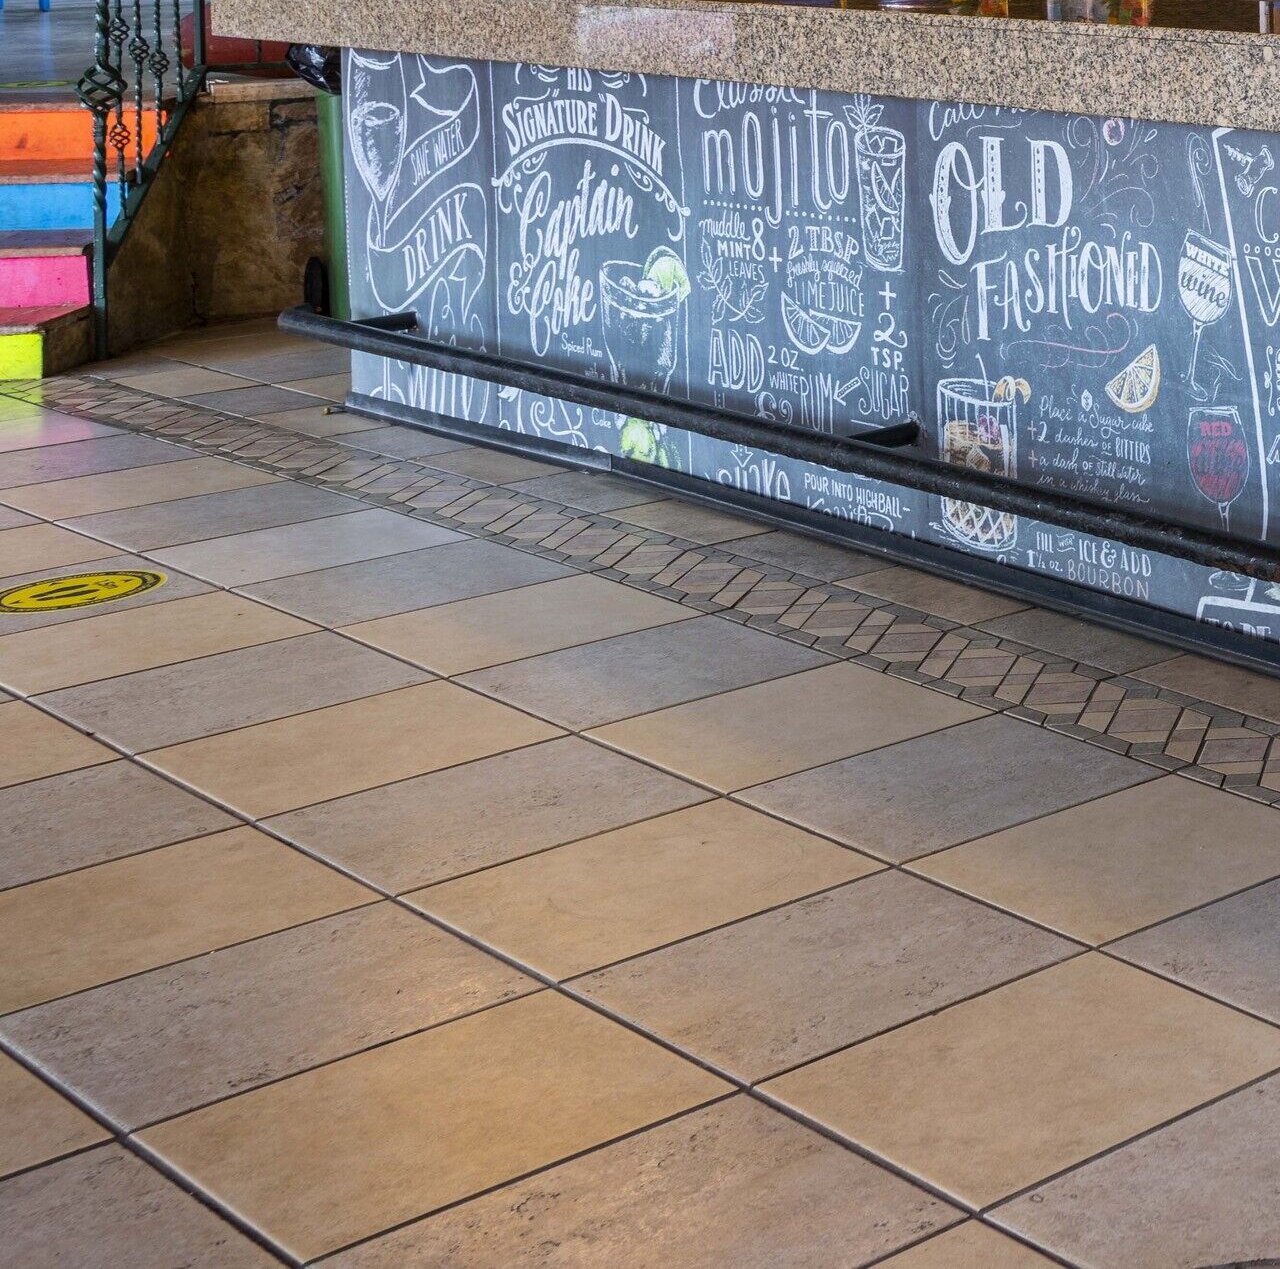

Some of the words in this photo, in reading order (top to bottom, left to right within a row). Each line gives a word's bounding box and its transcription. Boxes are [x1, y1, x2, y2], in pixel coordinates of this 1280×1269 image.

[410, 151, 431, 187] SAVE
[433, 119, 466, 170] WATER
[502, 92, 599, 158] SIGNATURE
[604, 92, 667, 178] DRINK
[702, 91, 850, 228] mojito
[930, 134, 1074, 266] OLD
[402, 193, 474, 293] DRINK
[698, 211, 751, 242] muddle
[806, 225, 860, 265] TBSP
[717, 240, 753, 262] MINT
[728, 260, 766, 284] LEAVES
[1184, 241, 1230, 278] WHITE
[969, 225, 1164, 342] FASHIONED
[1181, 269, 1228, 310] wine
[707, 328, 766, 394] ADD
[798, 373, 835, 433] RUM
[858, 366, 910, 420] SUGAR
[1115, 437, 1151, 465] BITTERS
[804, 472, 829, 495] POUR
[830, 480, 854, 503] INTO
[1067, 559, 1150, 602] BOURBON
[1120, 548, 1152, 577] ADD
